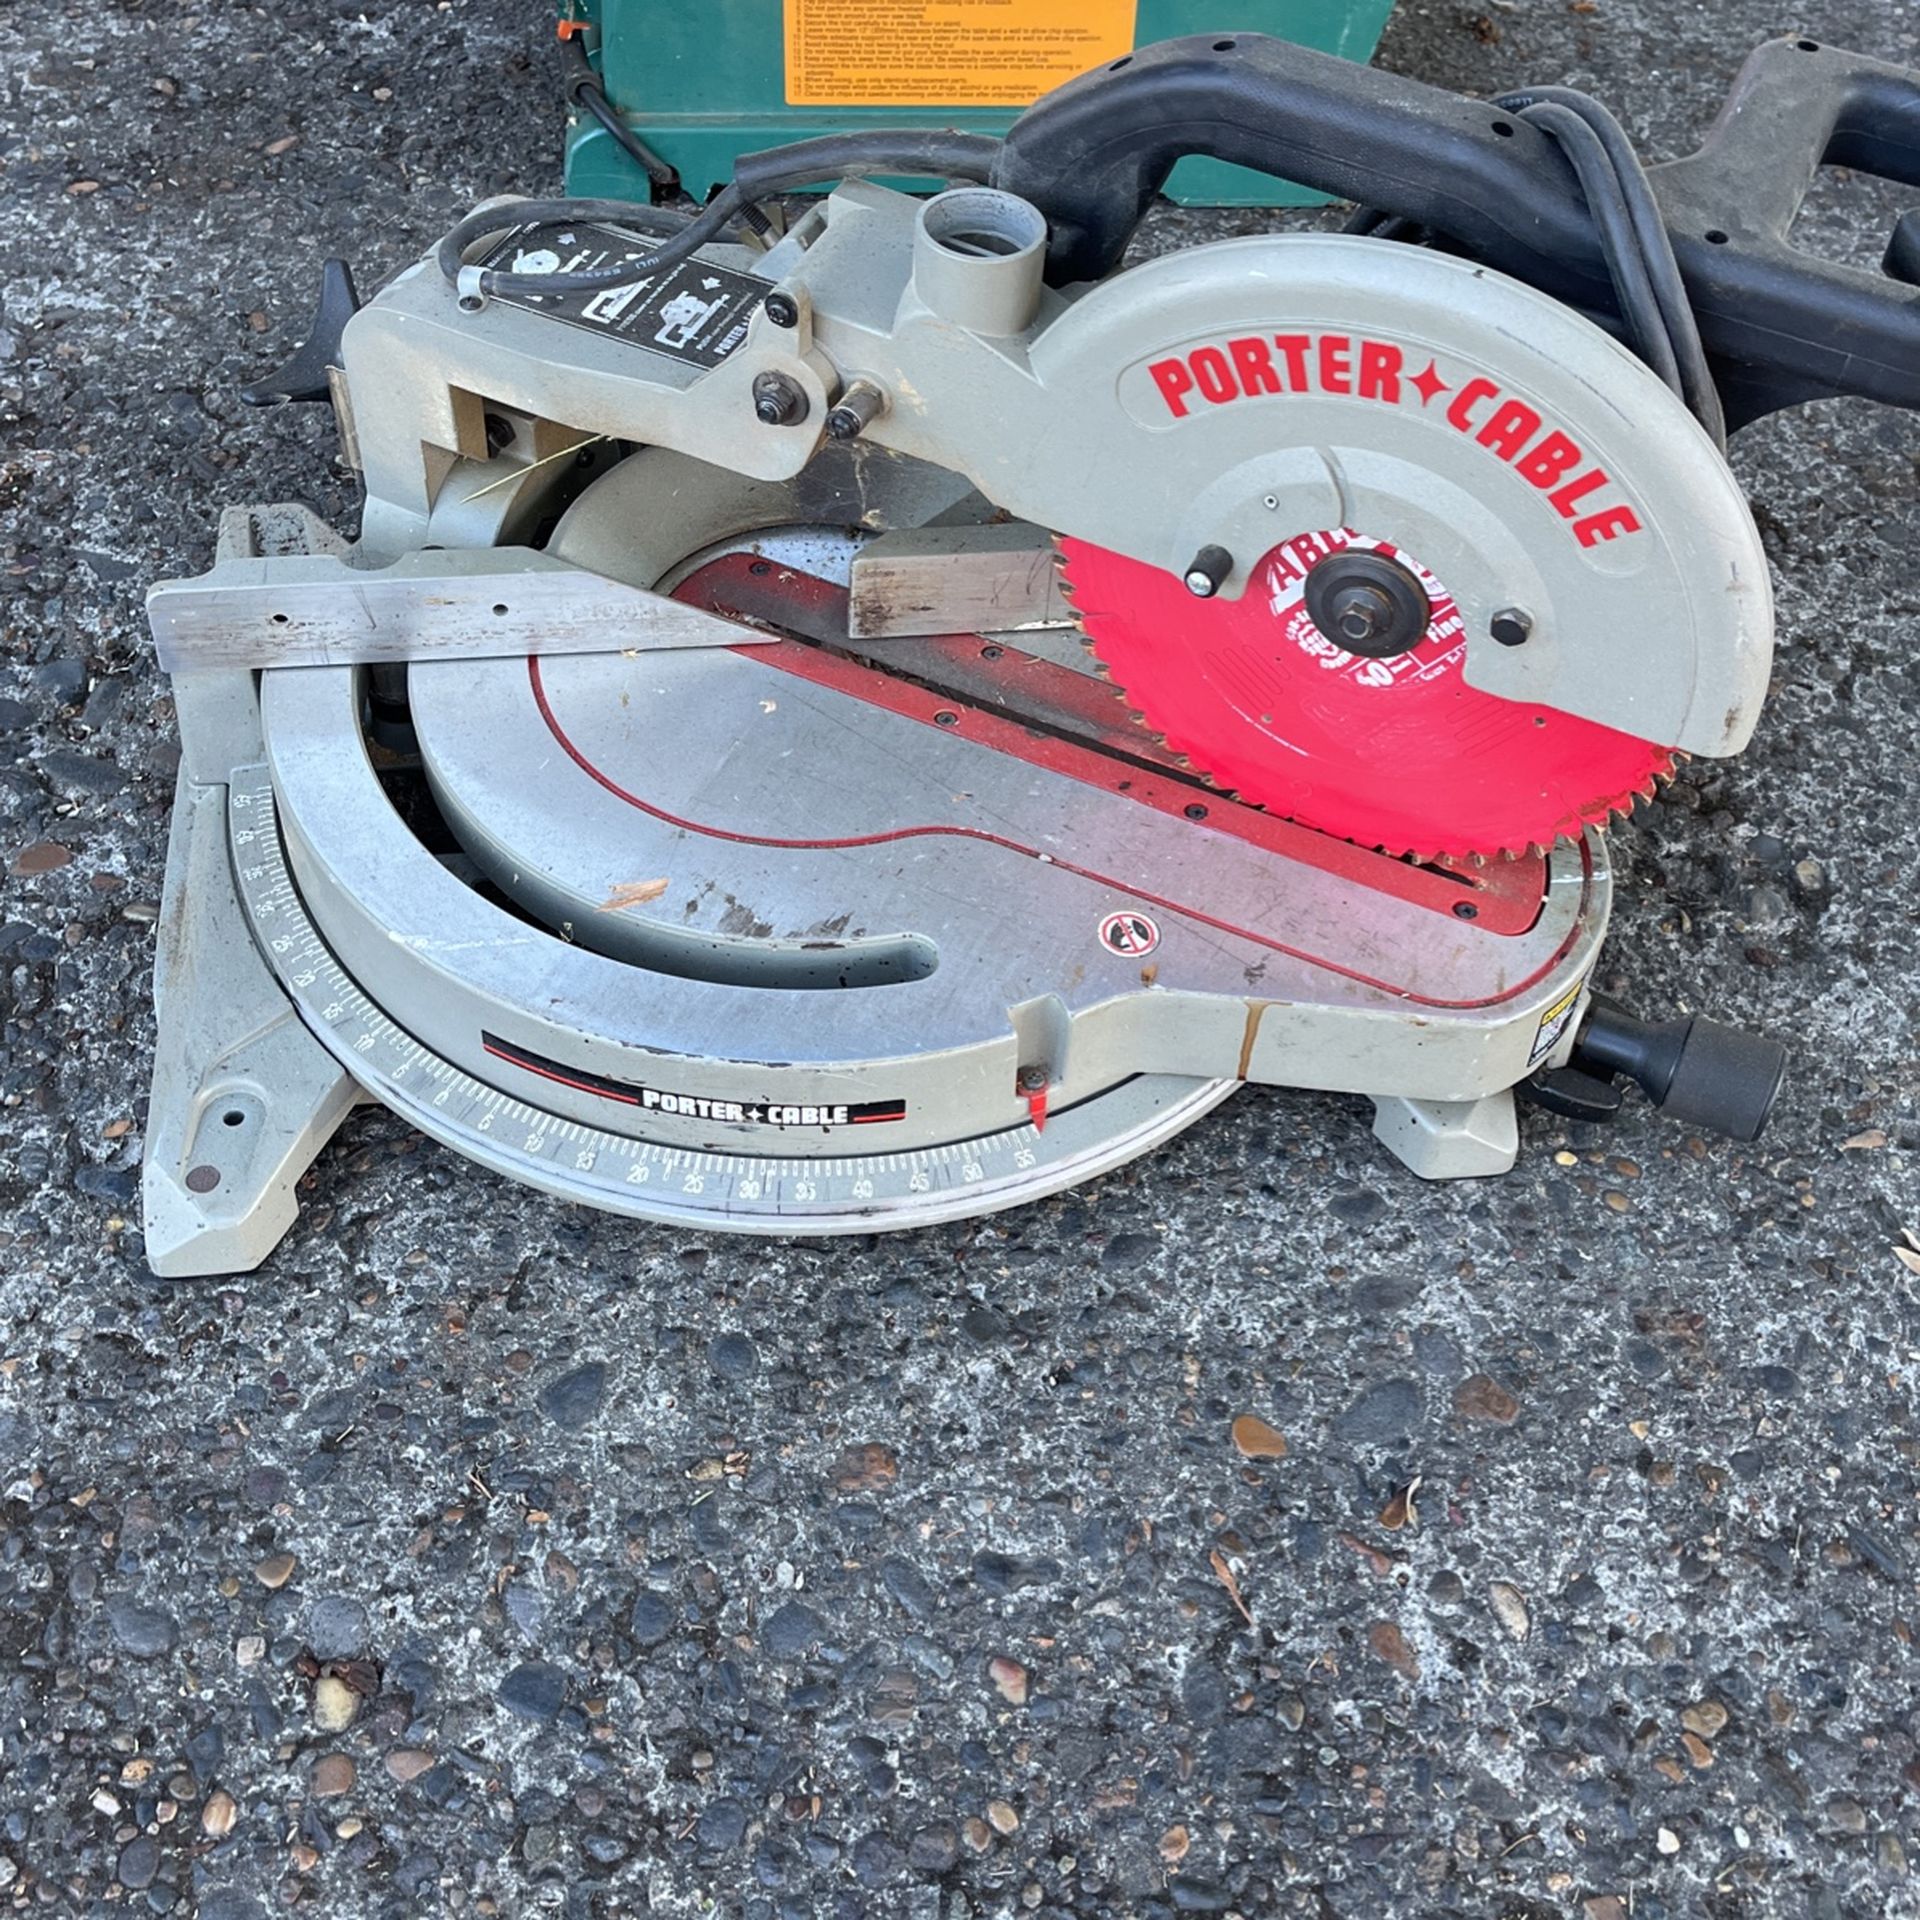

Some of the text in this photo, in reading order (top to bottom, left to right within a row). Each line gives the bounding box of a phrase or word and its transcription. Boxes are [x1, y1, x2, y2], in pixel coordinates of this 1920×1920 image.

[713, 325, 748, 355] PORTER
[1147, 334, 1643, 549] PORTER CABLE
[642, 1089, 848, 1125] PORTER CABLE
[478, 1114, 495, 1131] 5
[523, 1132, 545, 1152] 10
[575, 1150, 597, 1170] 15
[1013, 1148, 1037, 1169] 55
[626, 1164, 650, 1185] 20
[909, 1173, 930, 1192] 45
[962, 1162, 984, 1183] 50
[683, 1175, 704, 1194] 25
[739, 1180, 760, 1200] 30
[795, 1181, 816, 1201] 35
[852, 1179, 873, 1199] 40
